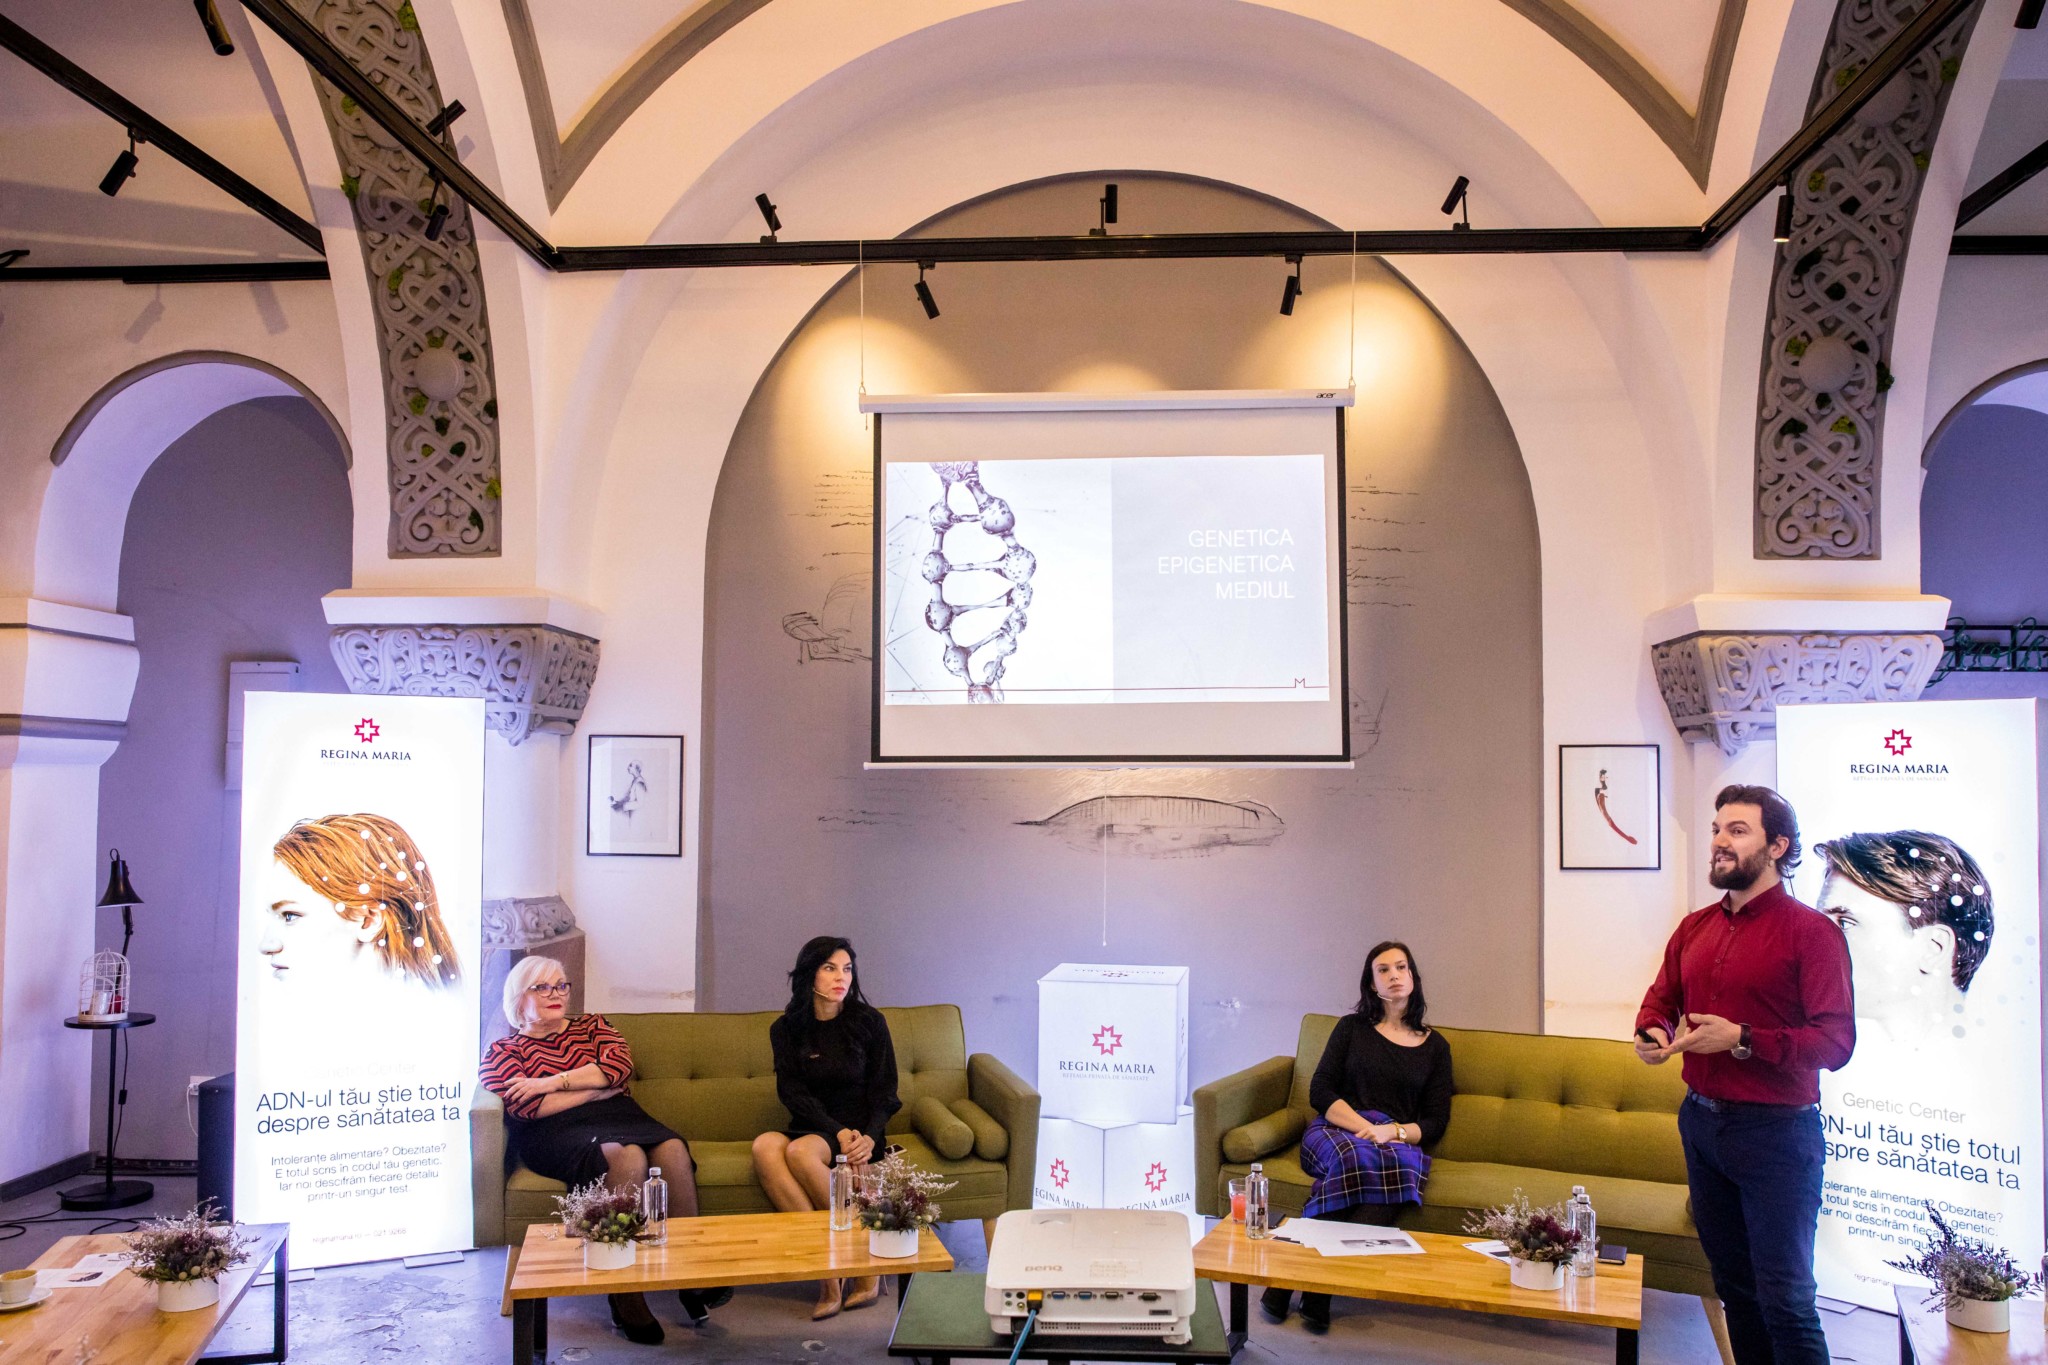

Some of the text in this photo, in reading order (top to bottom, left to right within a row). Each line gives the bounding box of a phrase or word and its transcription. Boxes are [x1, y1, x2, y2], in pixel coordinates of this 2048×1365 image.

[1188, 528, 1295, 548] GENETICA
[1158, 554, 1295, 574] EPIGENETICA
[1215, 580, 1295, 599] MEDIUL
[321, 749, 412, 761] REGINA MARIA
[1850, 764, 1949, 774] REGINA MARIA
[1060, 1061, 1155, 1074] REGINA MARIA
[256, 1081, 461, 1112] ADN-ul tău știe totul
[1842, 1092, 1966, 1123] Genetic Center
[257, 1104, 460, 1135] despre sănătatea ta
[1820, 1113, 2020, 1165] DN-ul tău știe totul
[271, 1143, 447, 1167] Intoleranțe alimentare? Obezitate?
[1825, 1141, 2020, 1190] spre sănătatea ta
[275, 1157, 442, 1179] E totul scris în codul tău genetic.
[279, 1169, 439, 1191] Iar noi descifrăm fiecare detaliu
[307, 1190, 352, 1203] printr-un
[355, 1187, 386, 1199] singur
[1035, 1187, 1060, 1205] EGINA
[1062, 1198, 1089, 1209] MARI
[1120, 1200, 1157, 1210] GINA
[1160, 1192, 1191, 1207] MARIA
[1824, 1181, 1867, 1197] oleranțe
[1870, 1189, 1935, 1208] alimentare?
[1938, 1201, 2003, 1223] Obezitate?
[1826, 1194, 1849, 1206] totul
[1853, 1200, 1878, 1212] scris
[1881, 1204, 1891, 1214] în
[1895, 1208, 1925, 1221] codul
[1951, 1218, 1998, 1236] genetic.
[1836, 1210, 1852, 1220] noi
[1856, 1213, 1910, 1231] descifrăm
[1913, 1224, 1945, 1238] fiecar
[1849, 1226, 1931, 1250] printr-un singu
